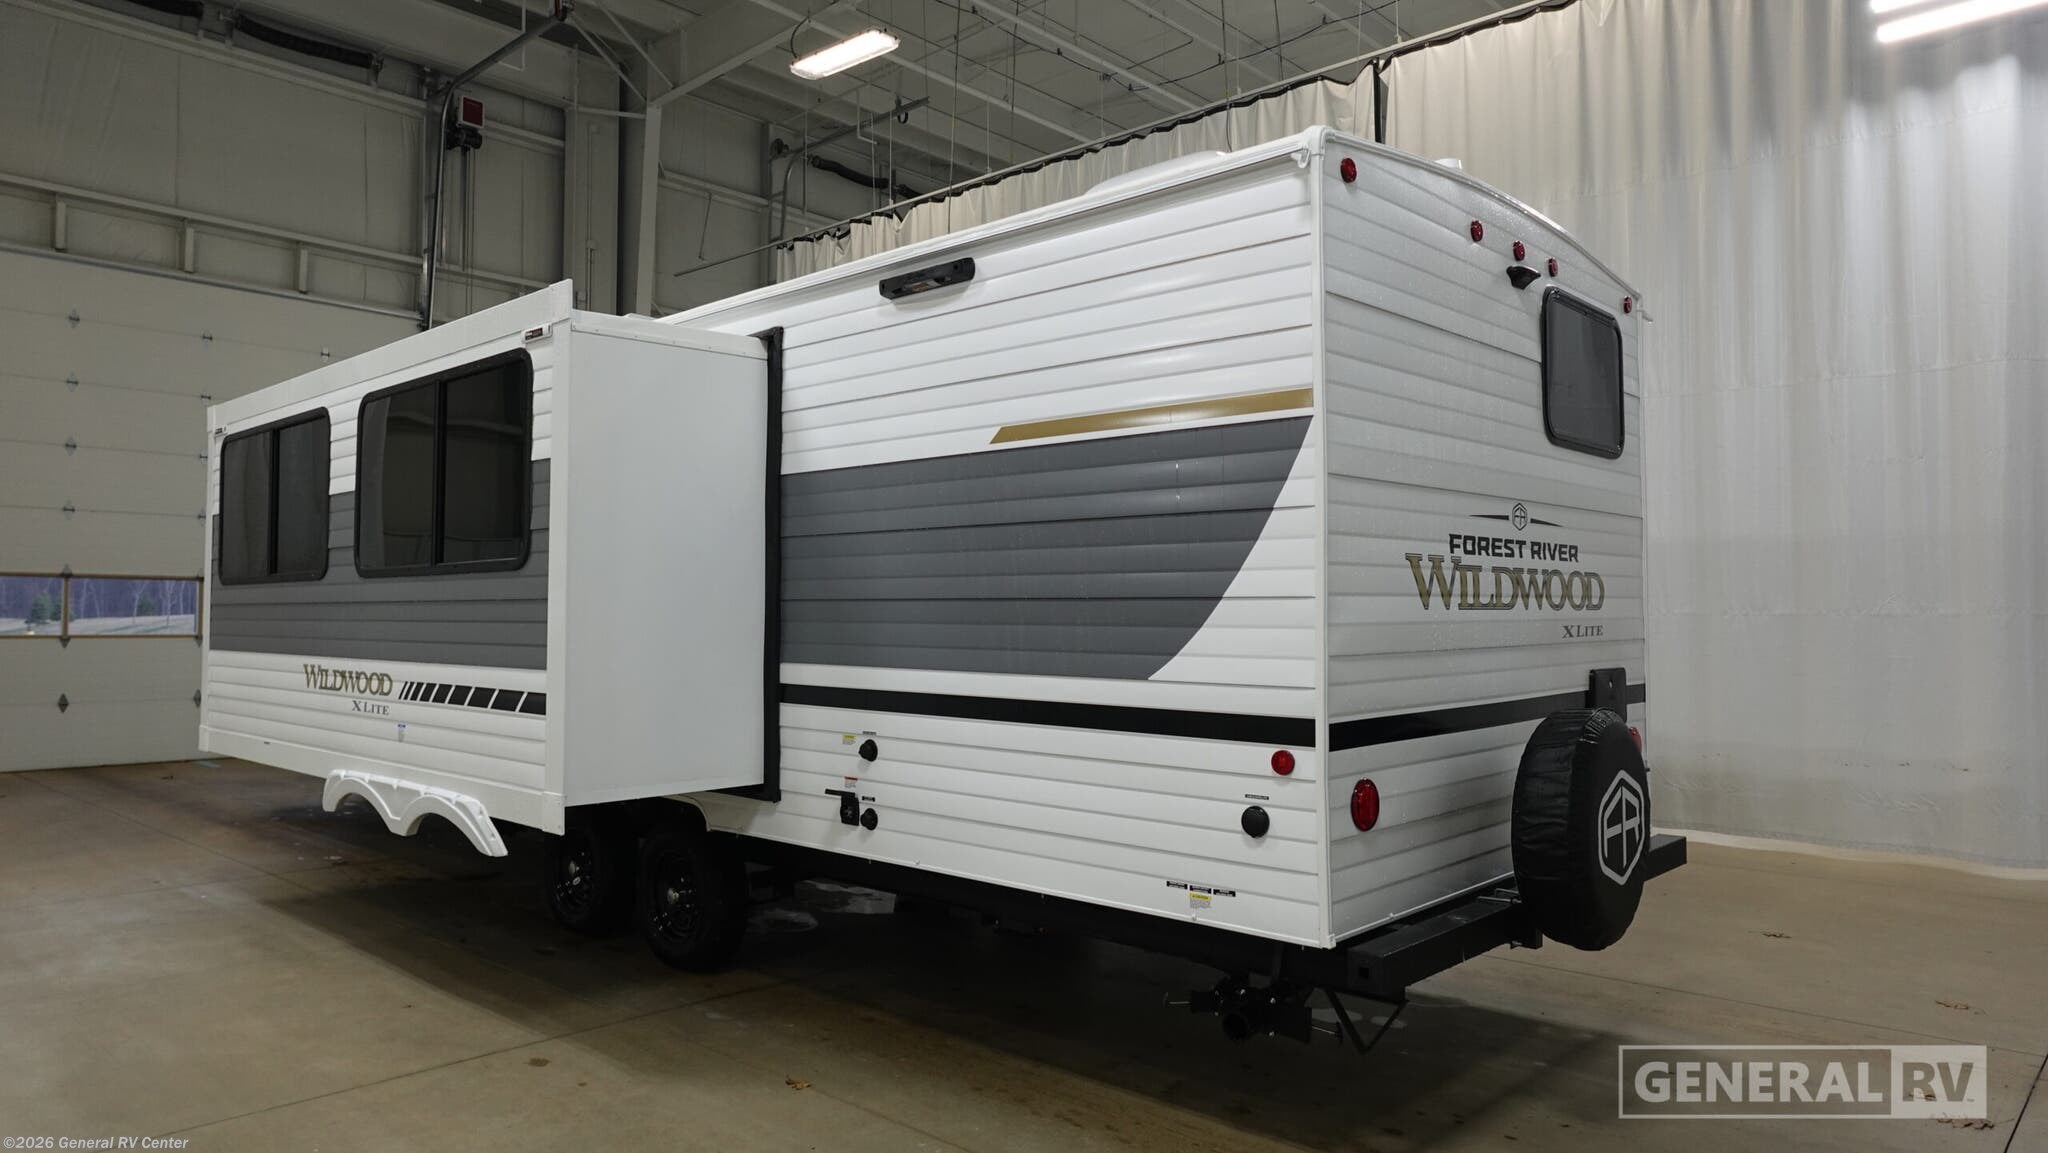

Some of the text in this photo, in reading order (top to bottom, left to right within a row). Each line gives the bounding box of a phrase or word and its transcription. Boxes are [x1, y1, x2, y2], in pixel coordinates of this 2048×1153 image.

[1449, 534, 1579, 562] FOREST RIVER
[1405, 553, 1605, 610] WILDWOOD
[303, 664, 393, 696] WILDWOOD
